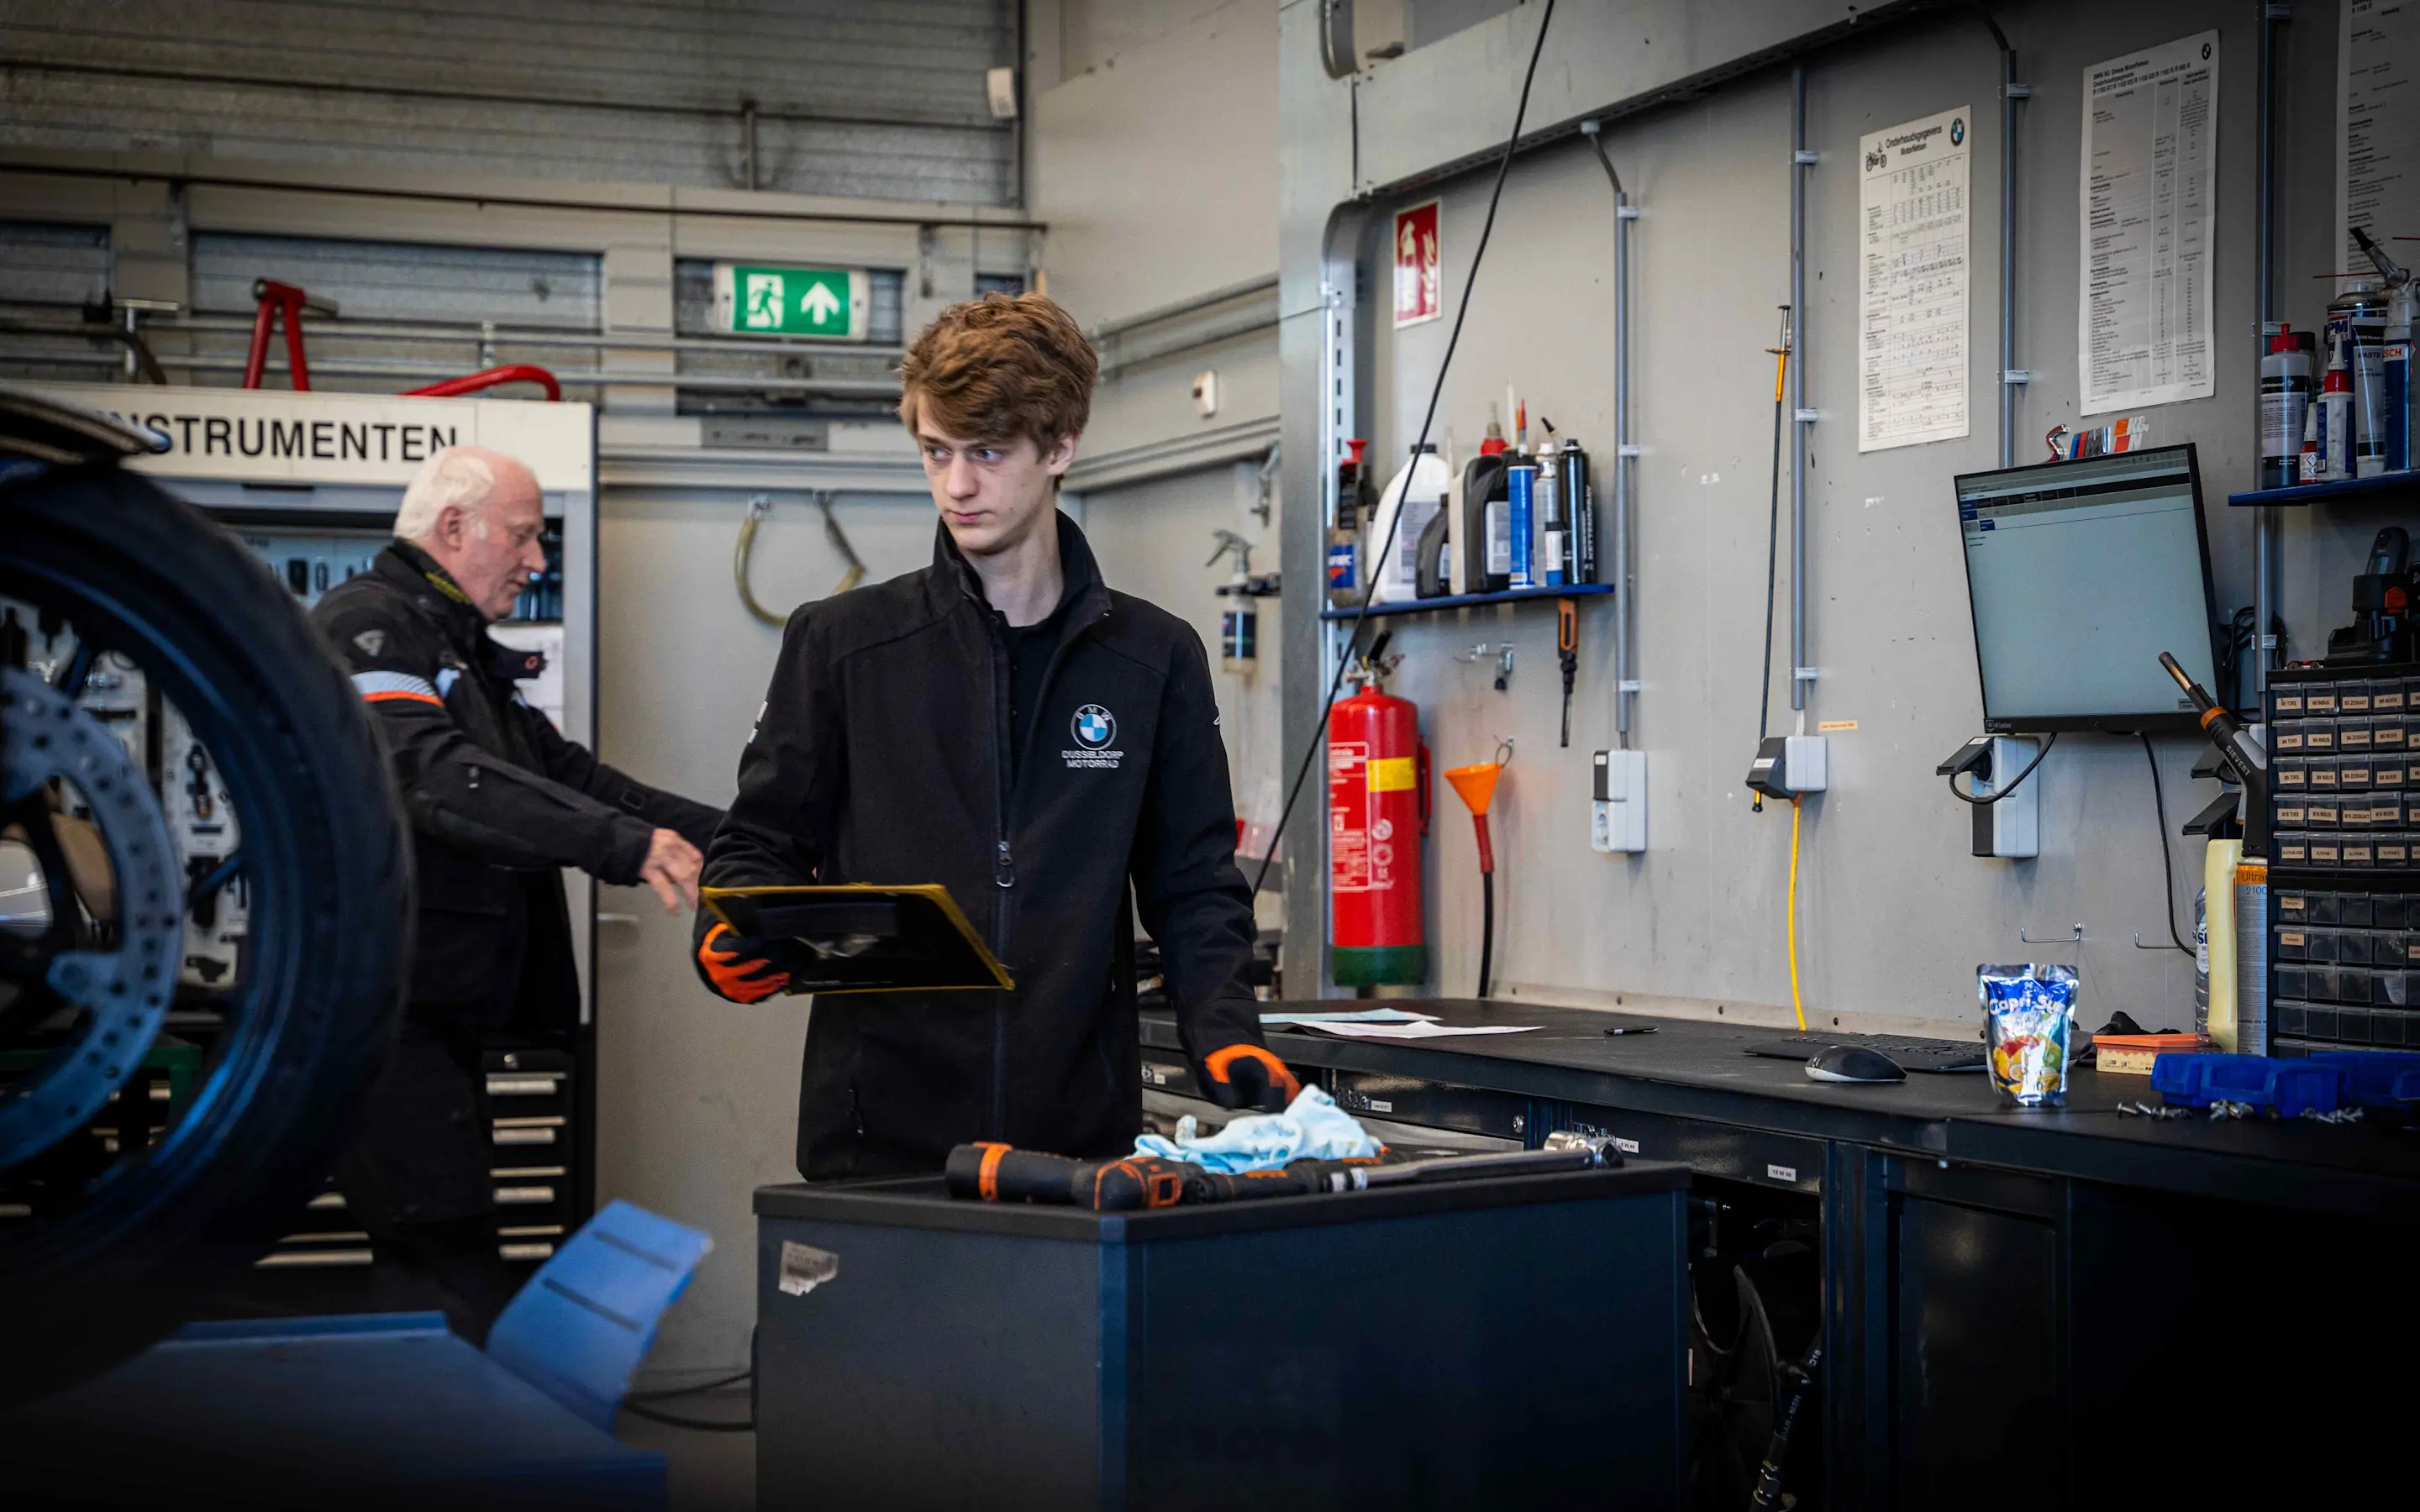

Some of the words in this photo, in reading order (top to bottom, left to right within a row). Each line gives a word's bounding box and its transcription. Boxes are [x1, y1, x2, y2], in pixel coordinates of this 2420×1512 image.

[1886, 125, 1943, 149] Onderhoudsgegevens
[1065, 759, 1119, 769] MOTORRAD
[2225, 744, 2251, 776] SIEVERT
